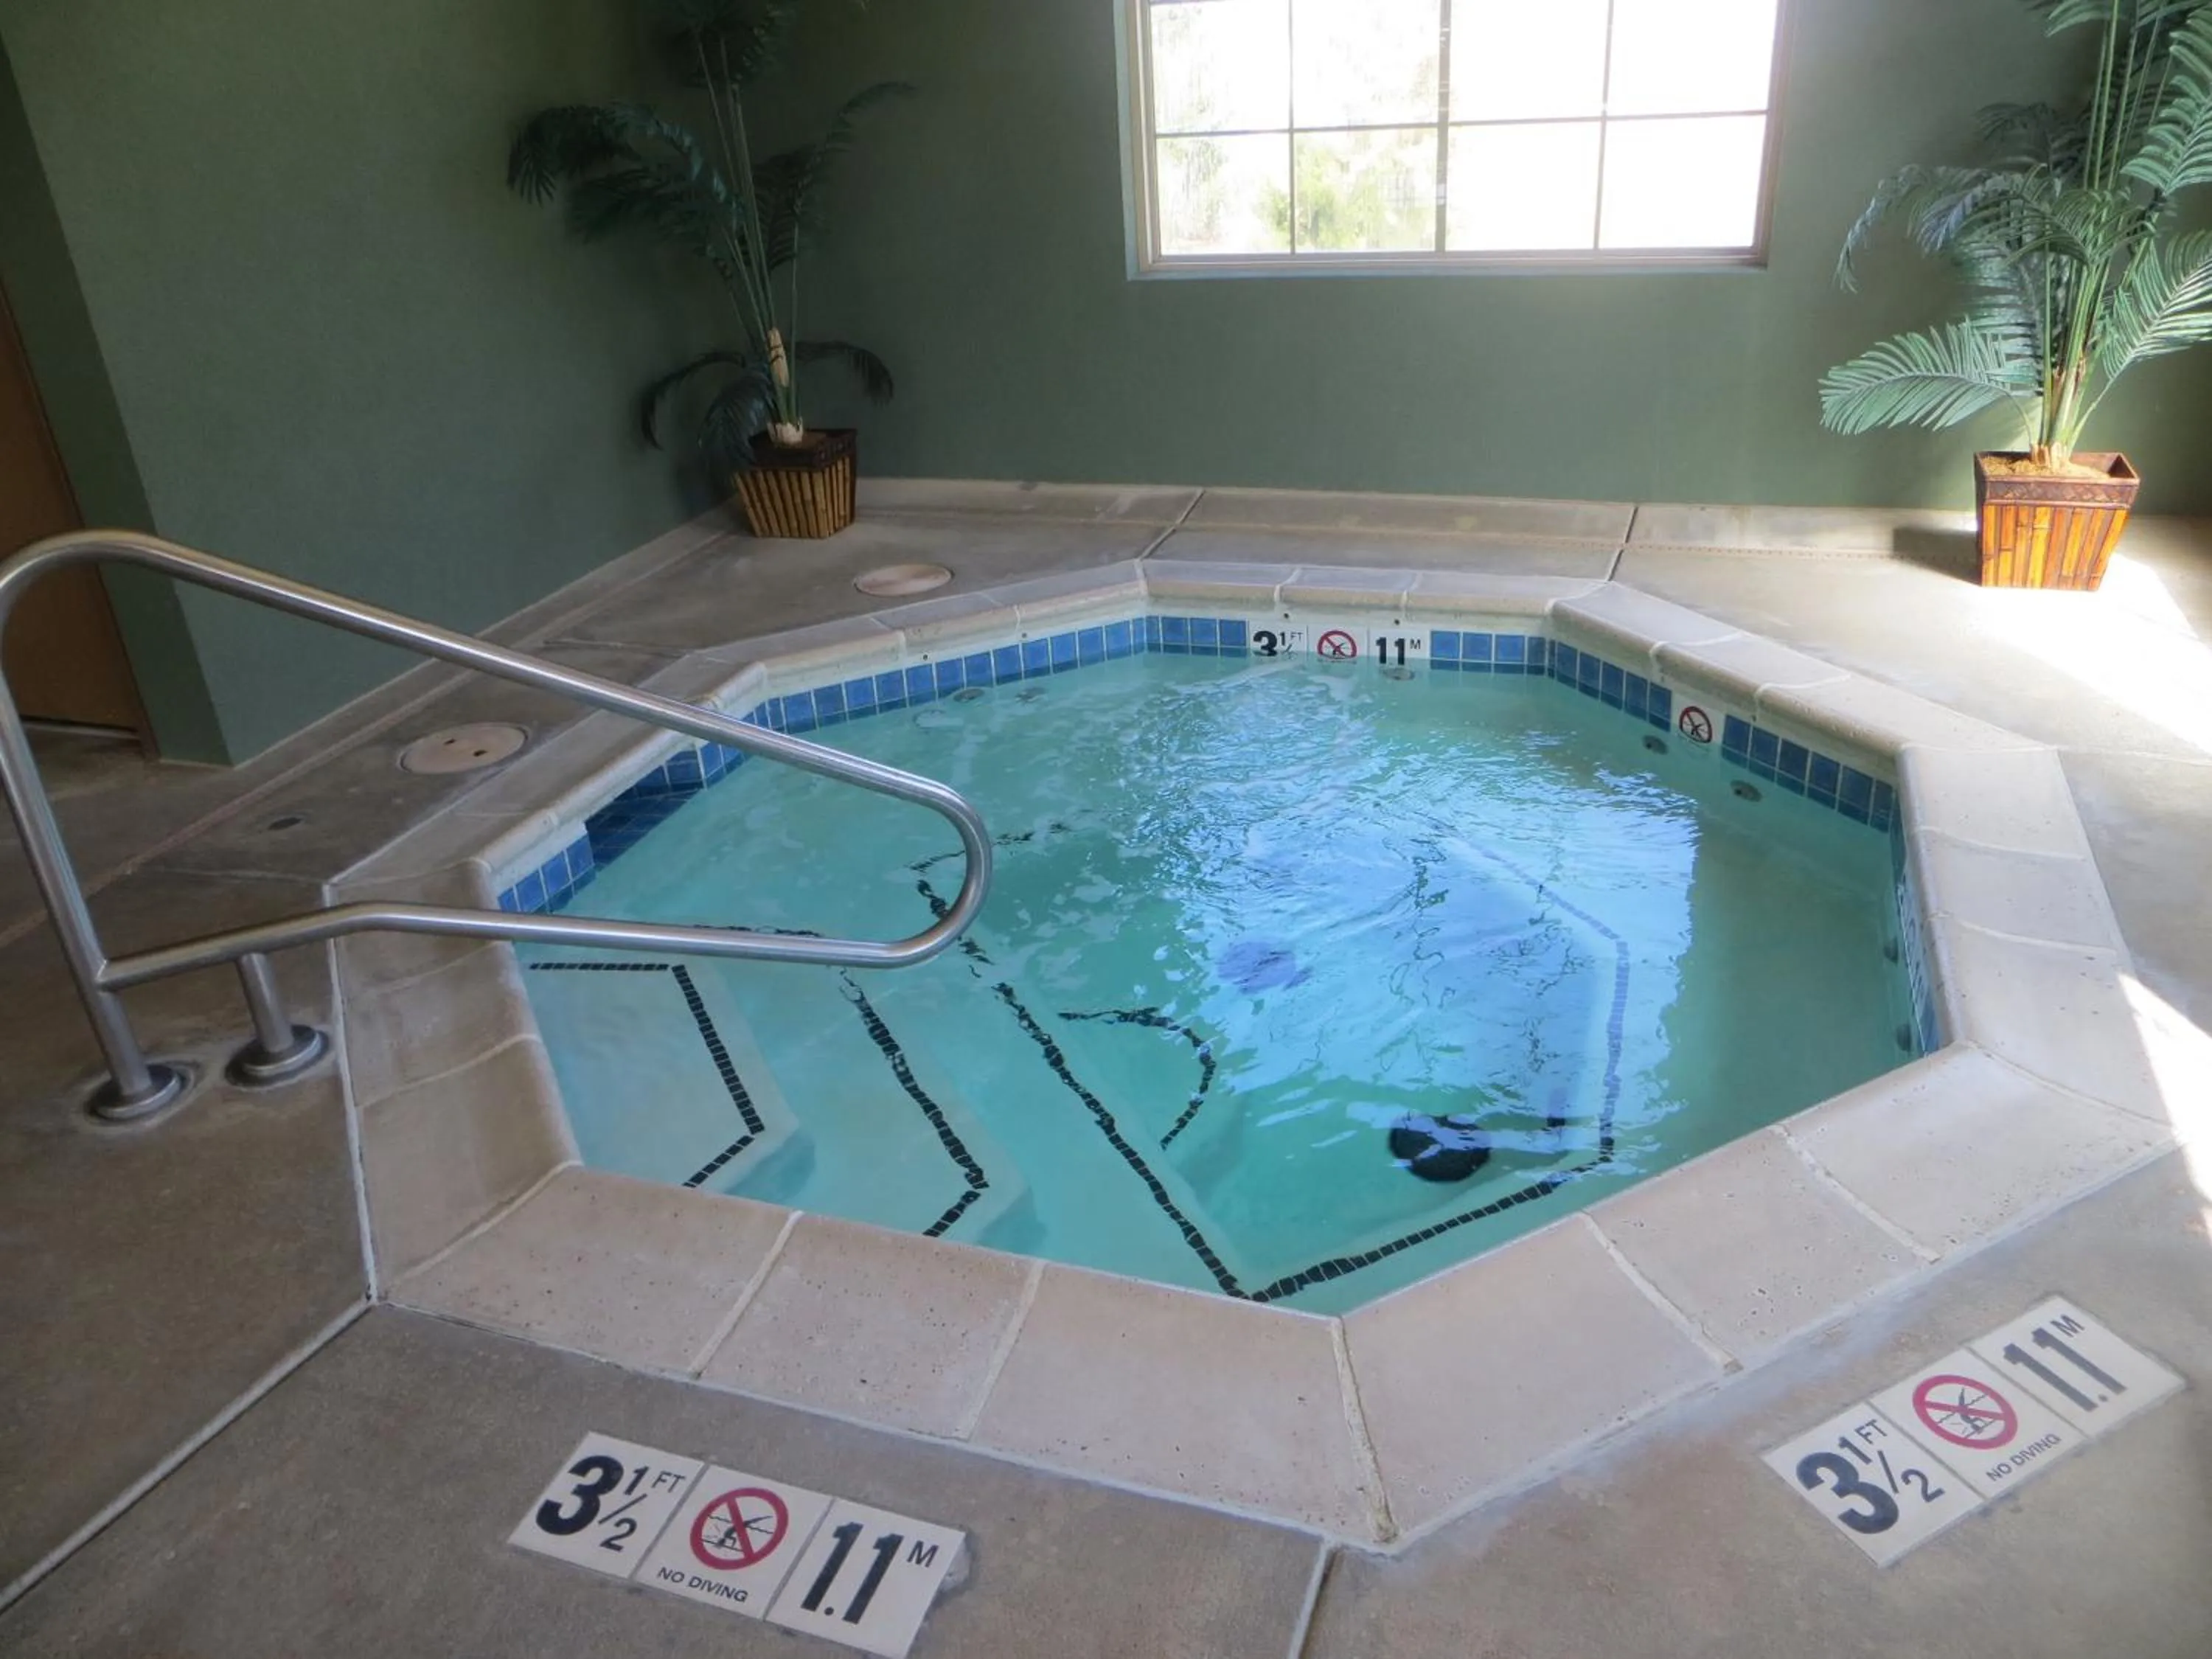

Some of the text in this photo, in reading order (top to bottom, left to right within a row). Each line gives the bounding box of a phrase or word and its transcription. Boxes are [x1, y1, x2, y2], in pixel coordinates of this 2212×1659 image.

[1410, 639, 1422, 650] M
[2003, 1315, 2127, 1412] 1.1 M
[536, 1455, 625, 1536] 3
[651, 1471, 686, 1493] FT
[1796, 1452, 1899, 1534] 3
[1854, 1419, 1888, 1444] FT
[1986, 1433, 2062, 1482] NO DIVING
[657, 1567, 748, 1603] NO DIVING
[801, 1521, 939, 1624] 1.1 M
